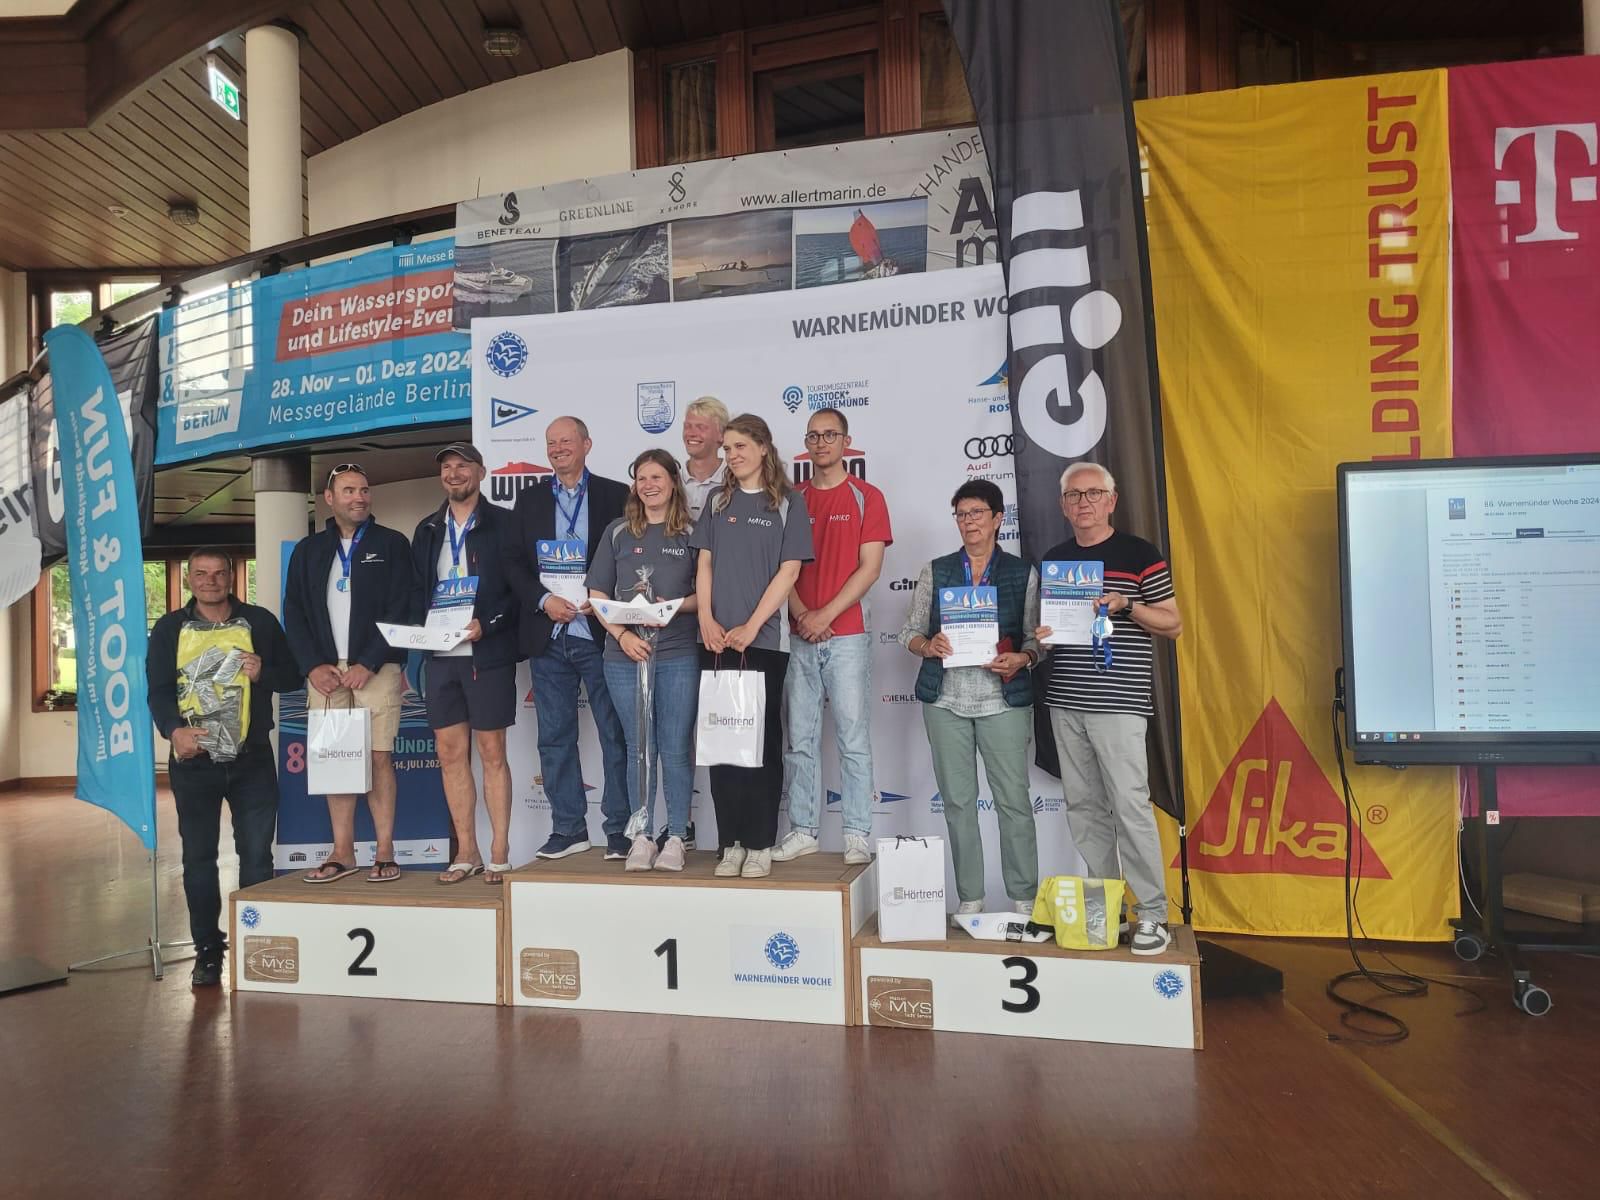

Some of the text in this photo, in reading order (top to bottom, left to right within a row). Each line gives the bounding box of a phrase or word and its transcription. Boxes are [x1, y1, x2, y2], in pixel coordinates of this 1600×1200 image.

[1367, 86, 1418, 278] TRUST
[1494, 122, 1598, 243] T
[741, 183, 887, 207] www.allertmarin.de
[559, 201, 634, 222] GREENLINE
[477, 227, 541, 240] BENETEAU
[416, 252, 446, 266] Messe
[292, 281, 455, 328] Dein Wasserspor
[792, 296, 1009, 338] WARNEMÜNDER WO
[288, 308, 453, 353] und Lifestyle-Eve
[271, 379, 294, 400] 28.
[300, 373, 334, 395] Nov
[355, 366, 377, 385] 01.
[382, 358, 416, 380] Dez
[421, 349, 472, 374] 2024
[1368, 293, 1422, 461] LDING
[268, 379, 471, 426] Messegelände Berlin
[992, 394, 1006, 402] und
[966, 461, 992, 471] Audi
[1553, 498, 1579, 506] Woche
[1581, 497, 1600, 505] 2024
[443, 633, 450, 643] 2
[407, 760, 424, 771] JULI
[425, 759, 442, 769] 202
[1199, 759, 1347, 861] Sika
[903, 887, 944, 900] Hörtrend
[346, 927, 378, 977] 2
[262, 958, 295, 970] MYS
[654, 938, 678, 990] 1
[540, 973, 576, 985] MYS
[734, 973, 832, 987] WARNEMÜNDER WOCHE
[1001, 956, 1041, 1014] 3
[890, 1000, 932, 1014] MYS
